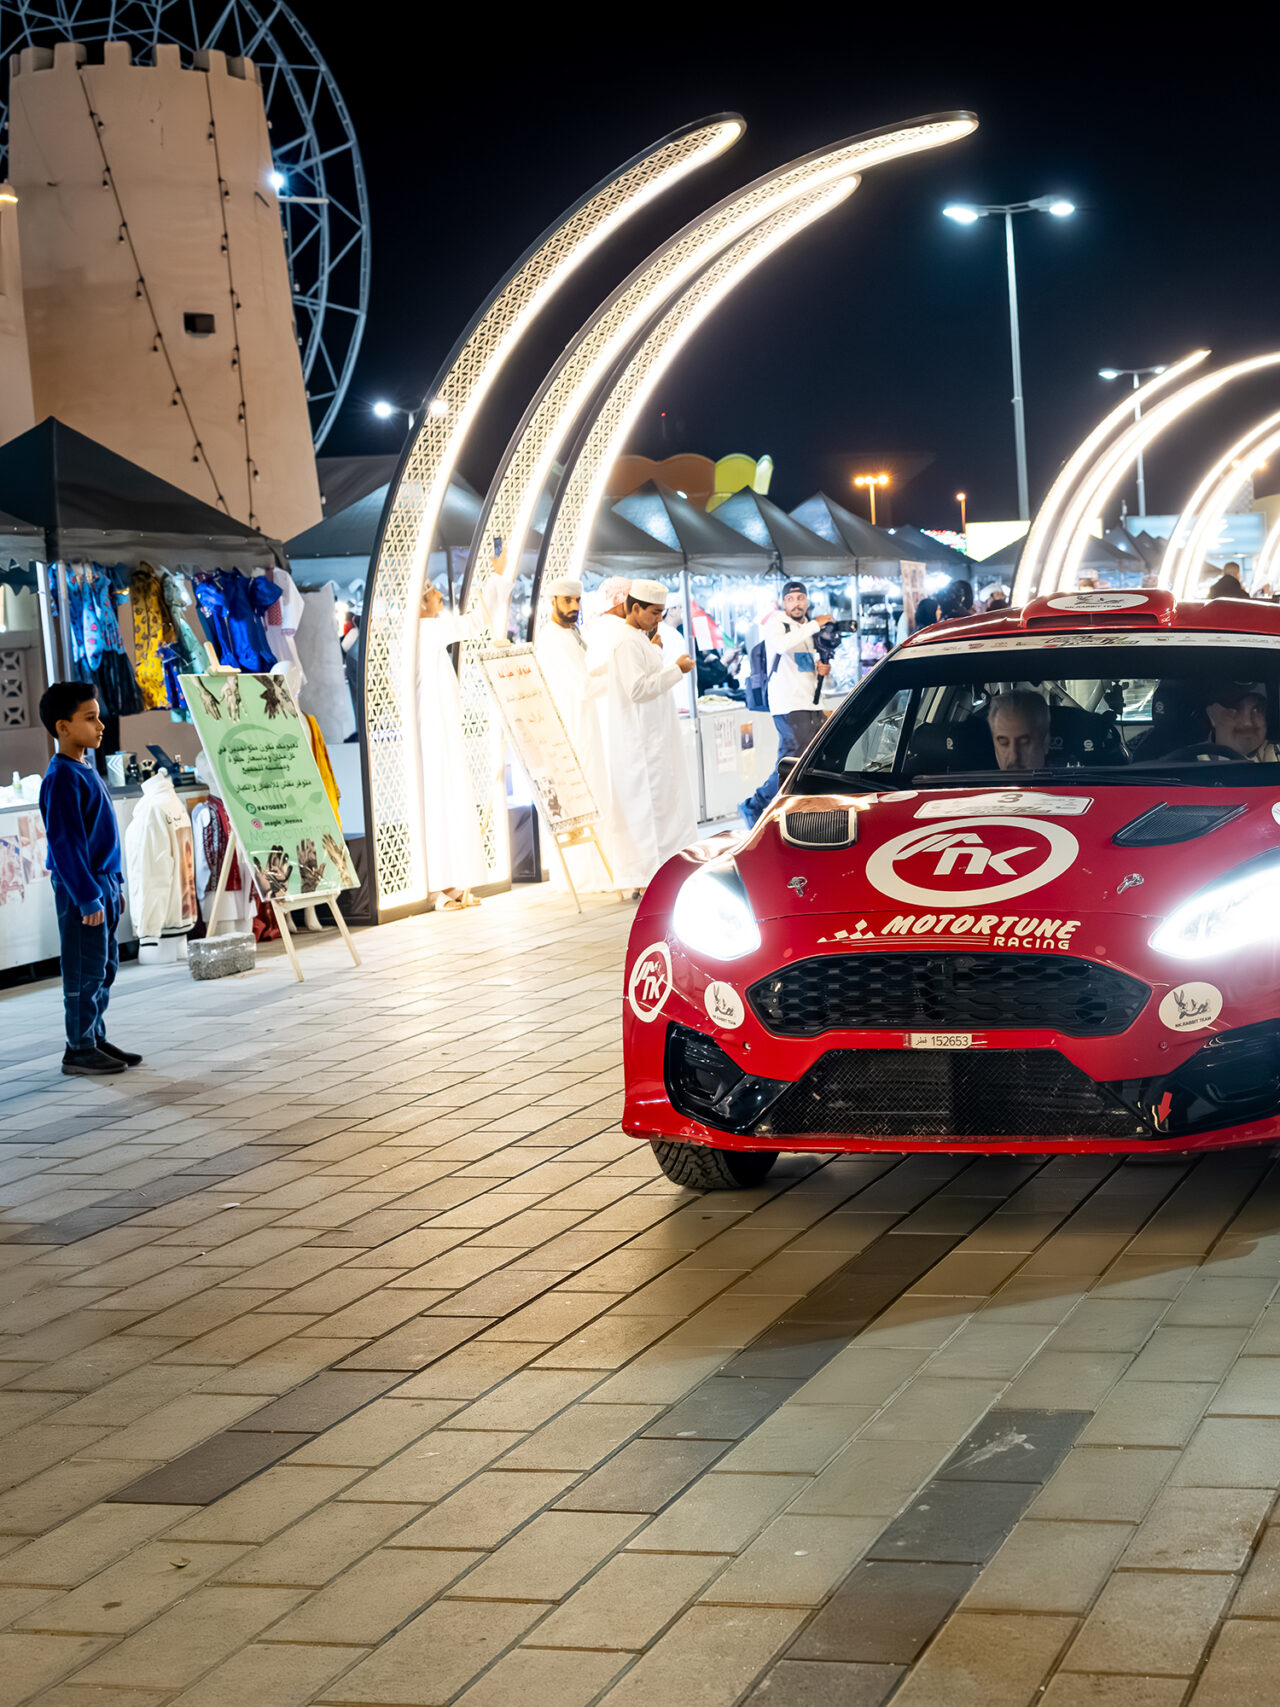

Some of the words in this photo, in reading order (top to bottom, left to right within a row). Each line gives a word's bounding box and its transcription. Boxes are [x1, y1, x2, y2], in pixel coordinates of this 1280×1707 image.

[997, 793, 1024, 804] 3
[881, 914, 1081, 939] MOTORTUNE
[993, 936, 1070, 950] RACING
[931, 1035, 969, 1047] 152653
